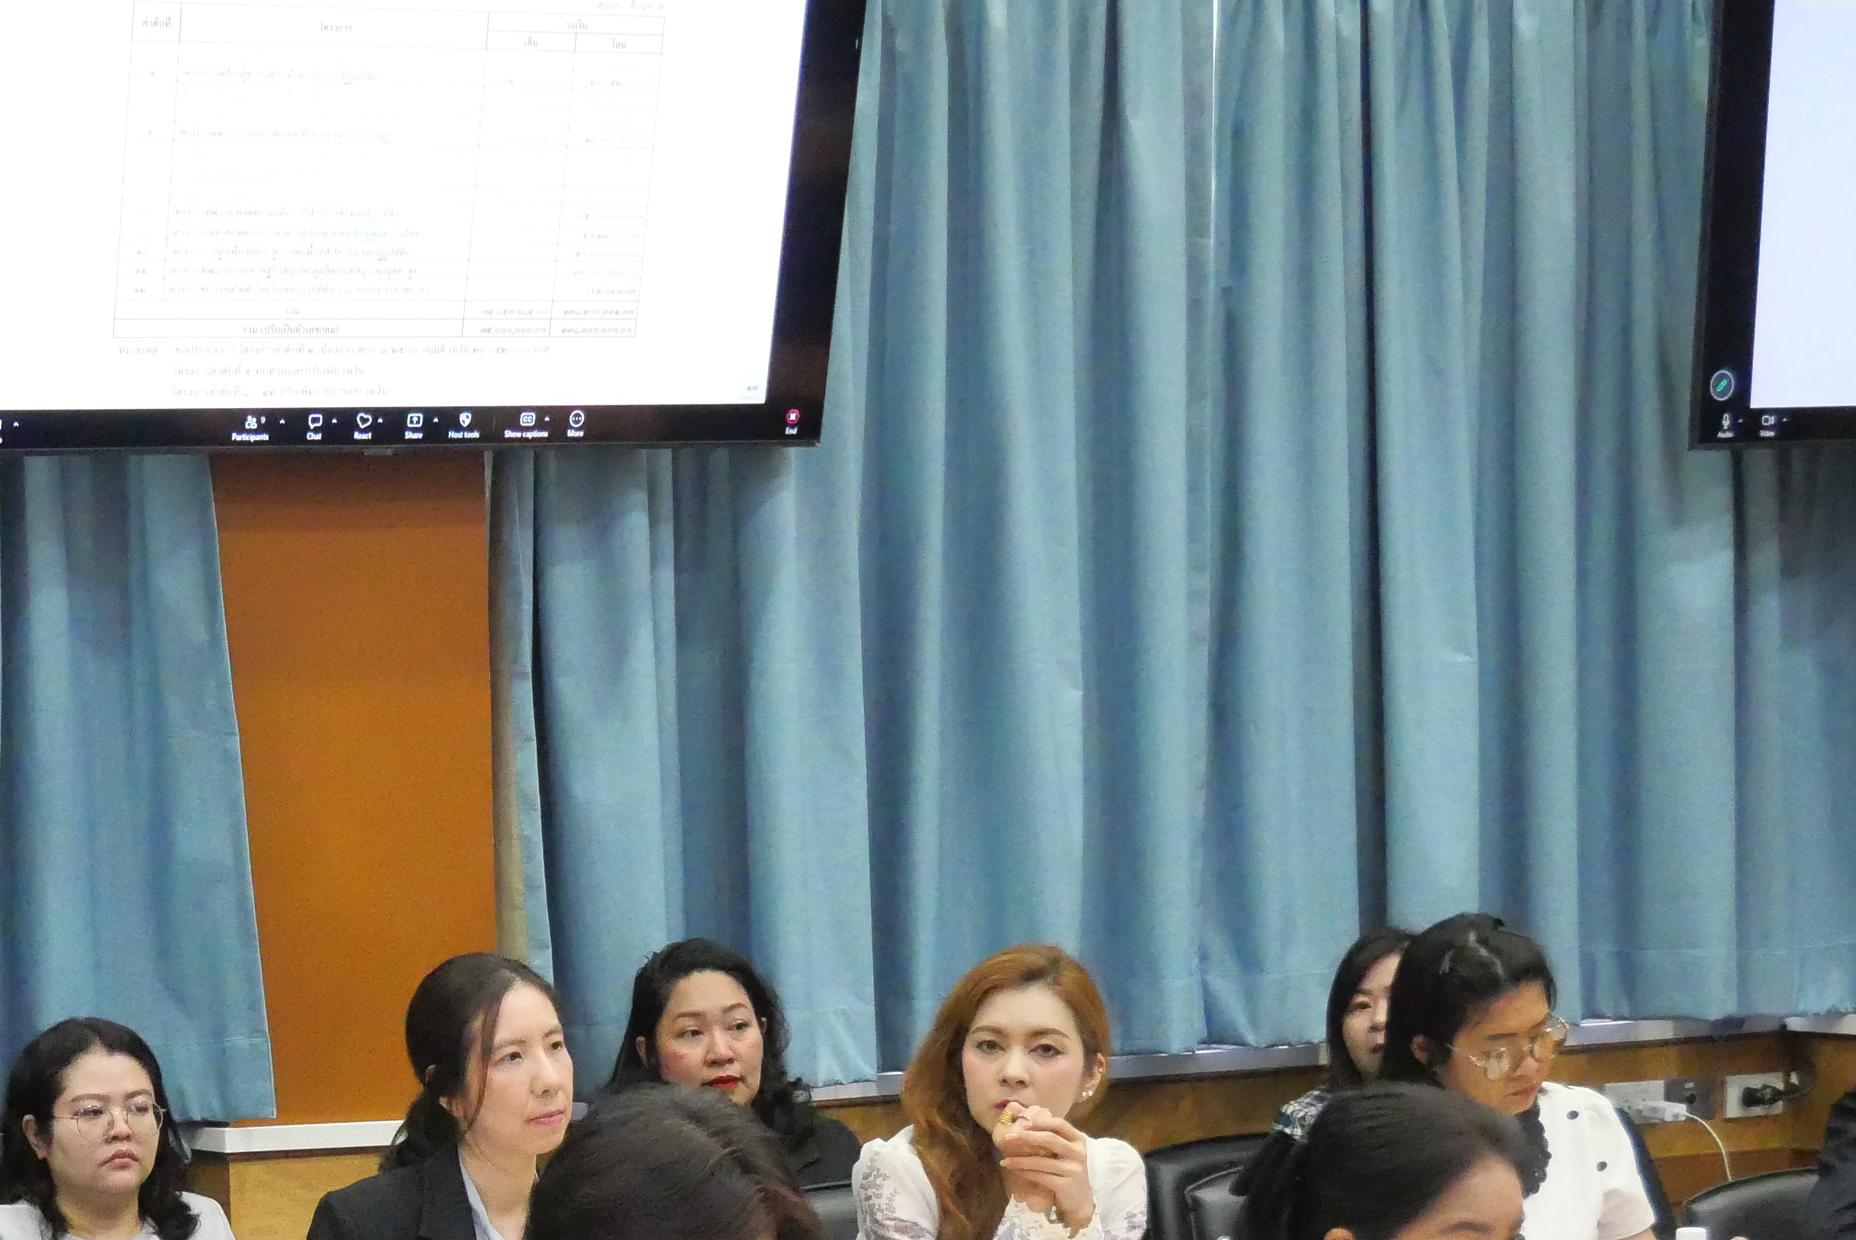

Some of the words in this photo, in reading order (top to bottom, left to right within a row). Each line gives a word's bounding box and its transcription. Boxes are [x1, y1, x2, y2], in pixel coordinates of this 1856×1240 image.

[353, 431, 372, 440] React
[404, 430, 424, 439] Share
[448, 430, 463, 438] Host
[464, 430, 480, 439] tools
[504, 430, 520, 438] Show
[521, 429, 549, 439] captions
[567, 429, 584, 437] More
[785, 427, 798, 435] End
[231, 432, 270, 442] Participants
[306, 432, 322, 441] Chat
